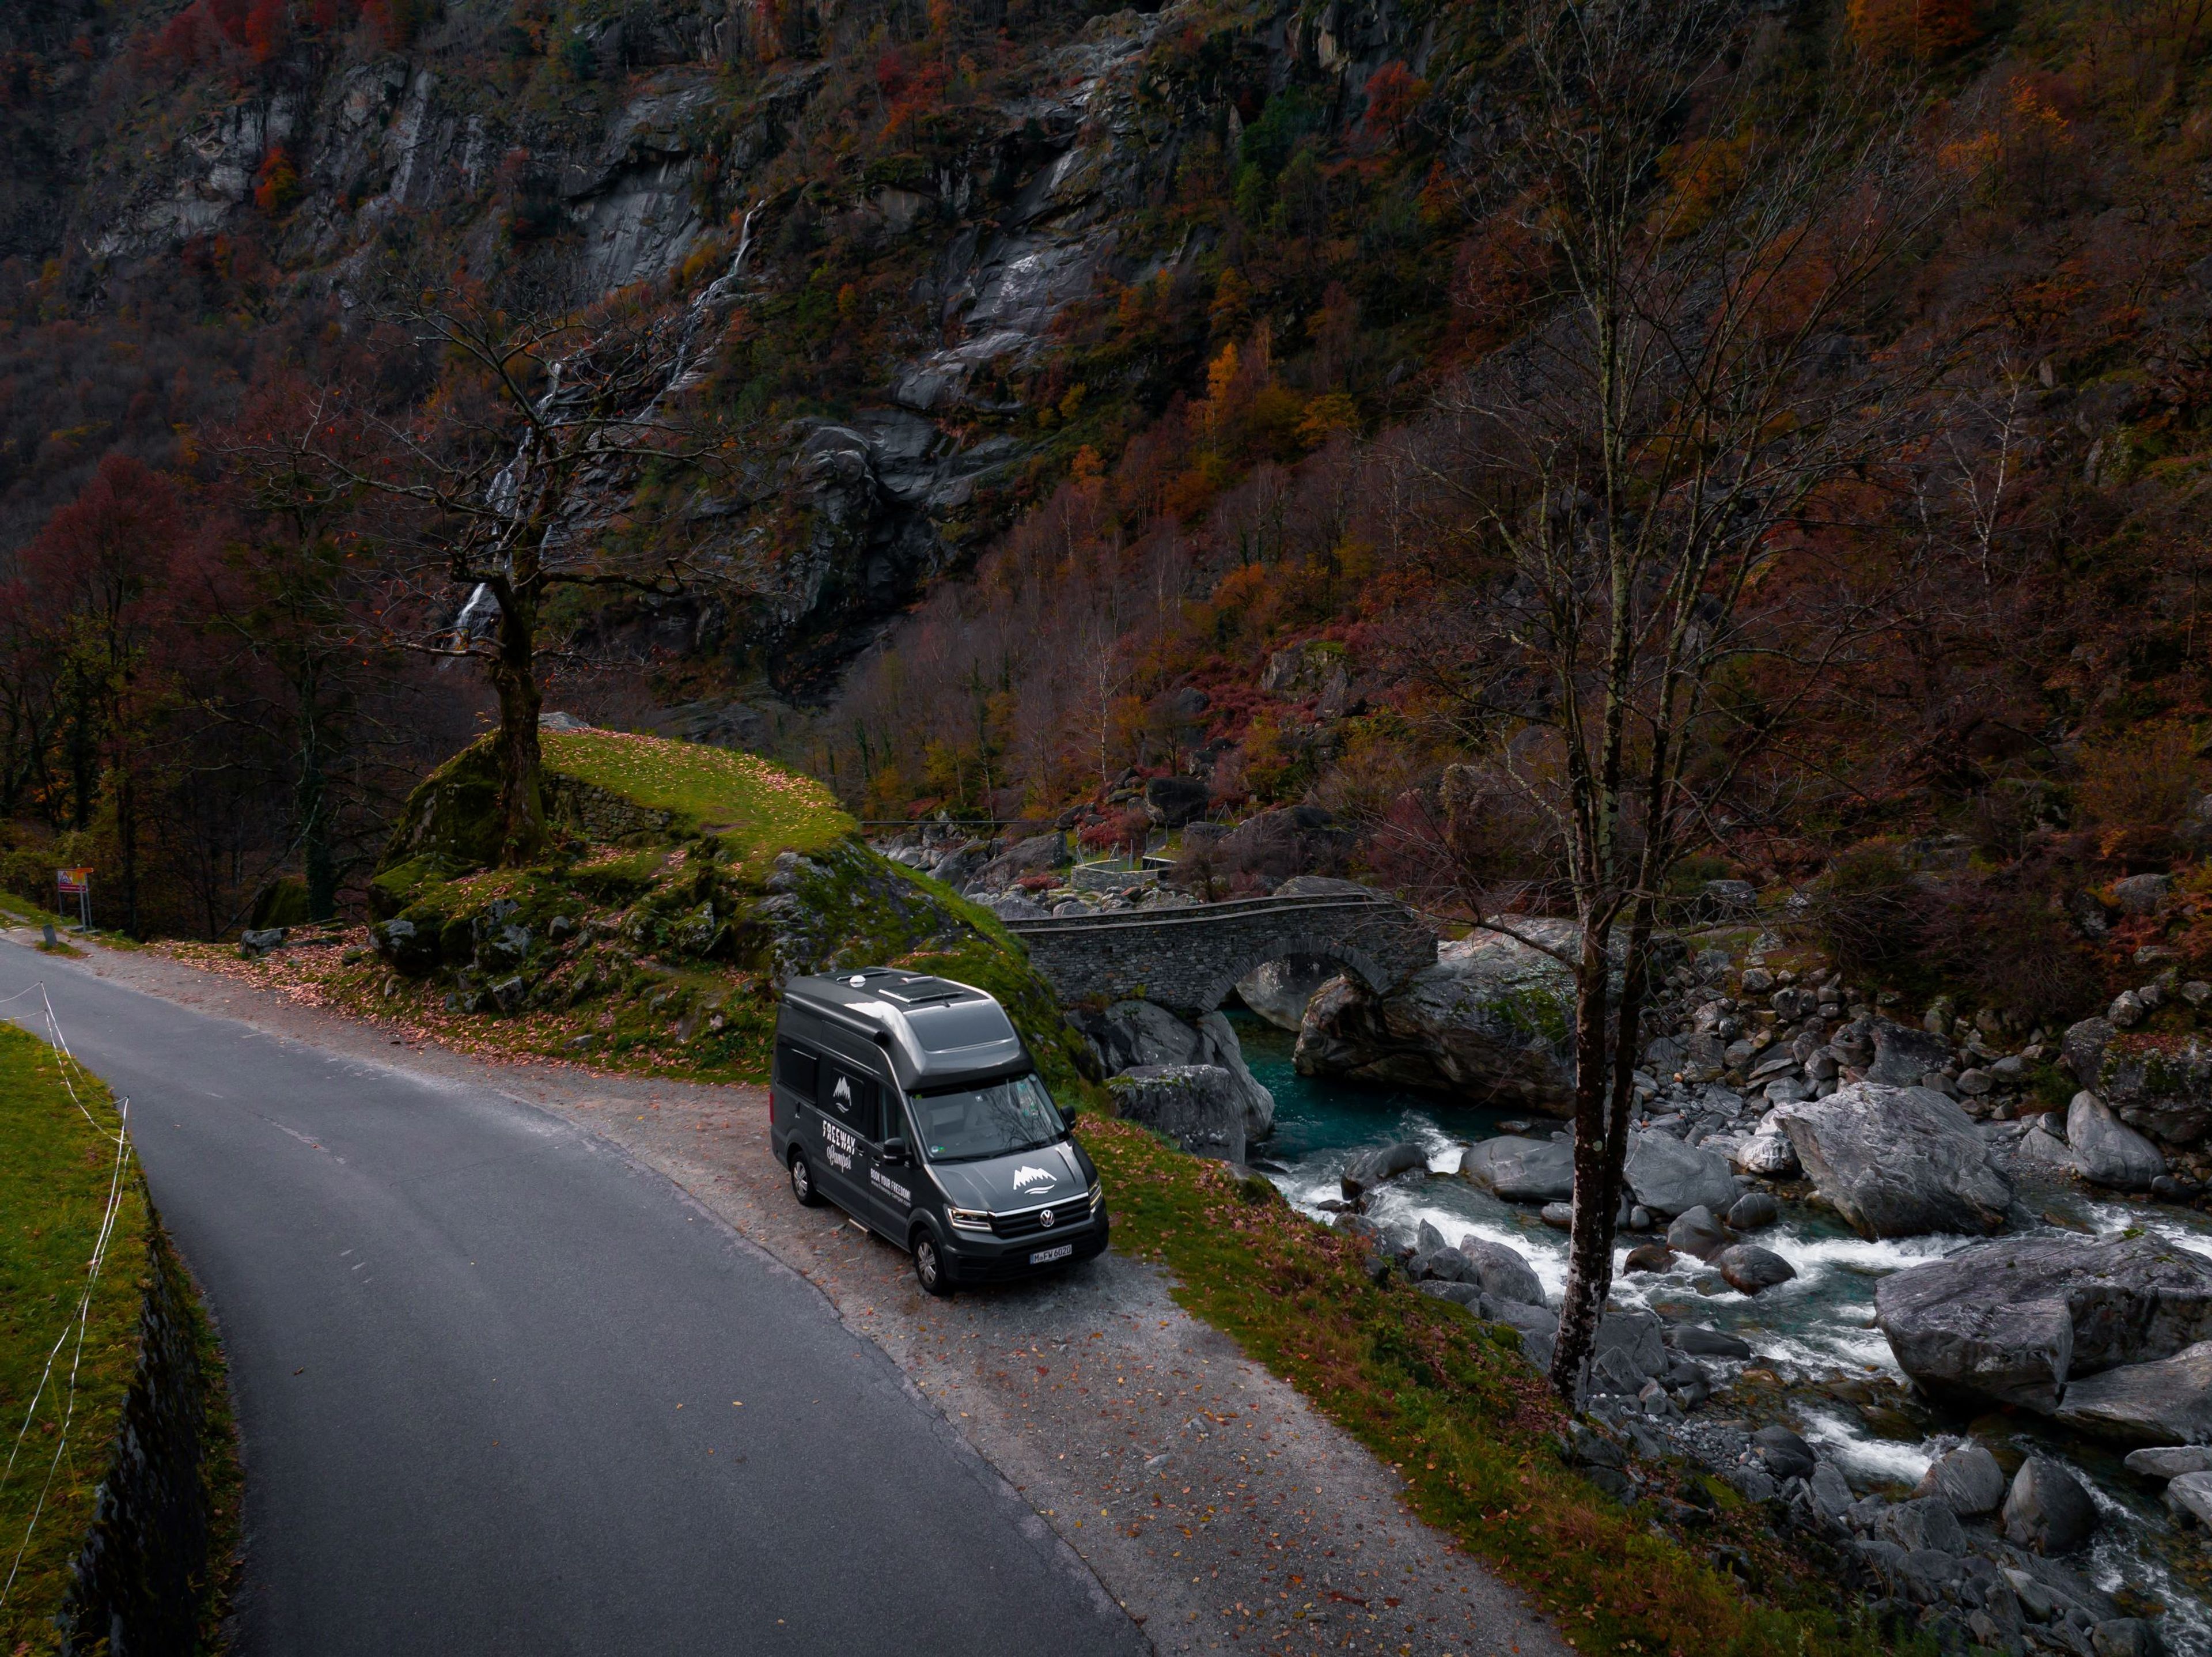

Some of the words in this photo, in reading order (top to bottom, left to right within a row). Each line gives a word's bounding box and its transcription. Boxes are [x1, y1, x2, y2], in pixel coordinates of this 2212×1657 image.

[823, 1119, 855, 1155] FREEWAY
[827, 1144, 851, 1173] Camper
[870, 1168, 880, 1183] BOOK
[880, 1173, 891, 1189] YOUR
[891, 1180, 911, 1201] FREEDOM!
[1054, 1246, 1071, 1257] 6020
